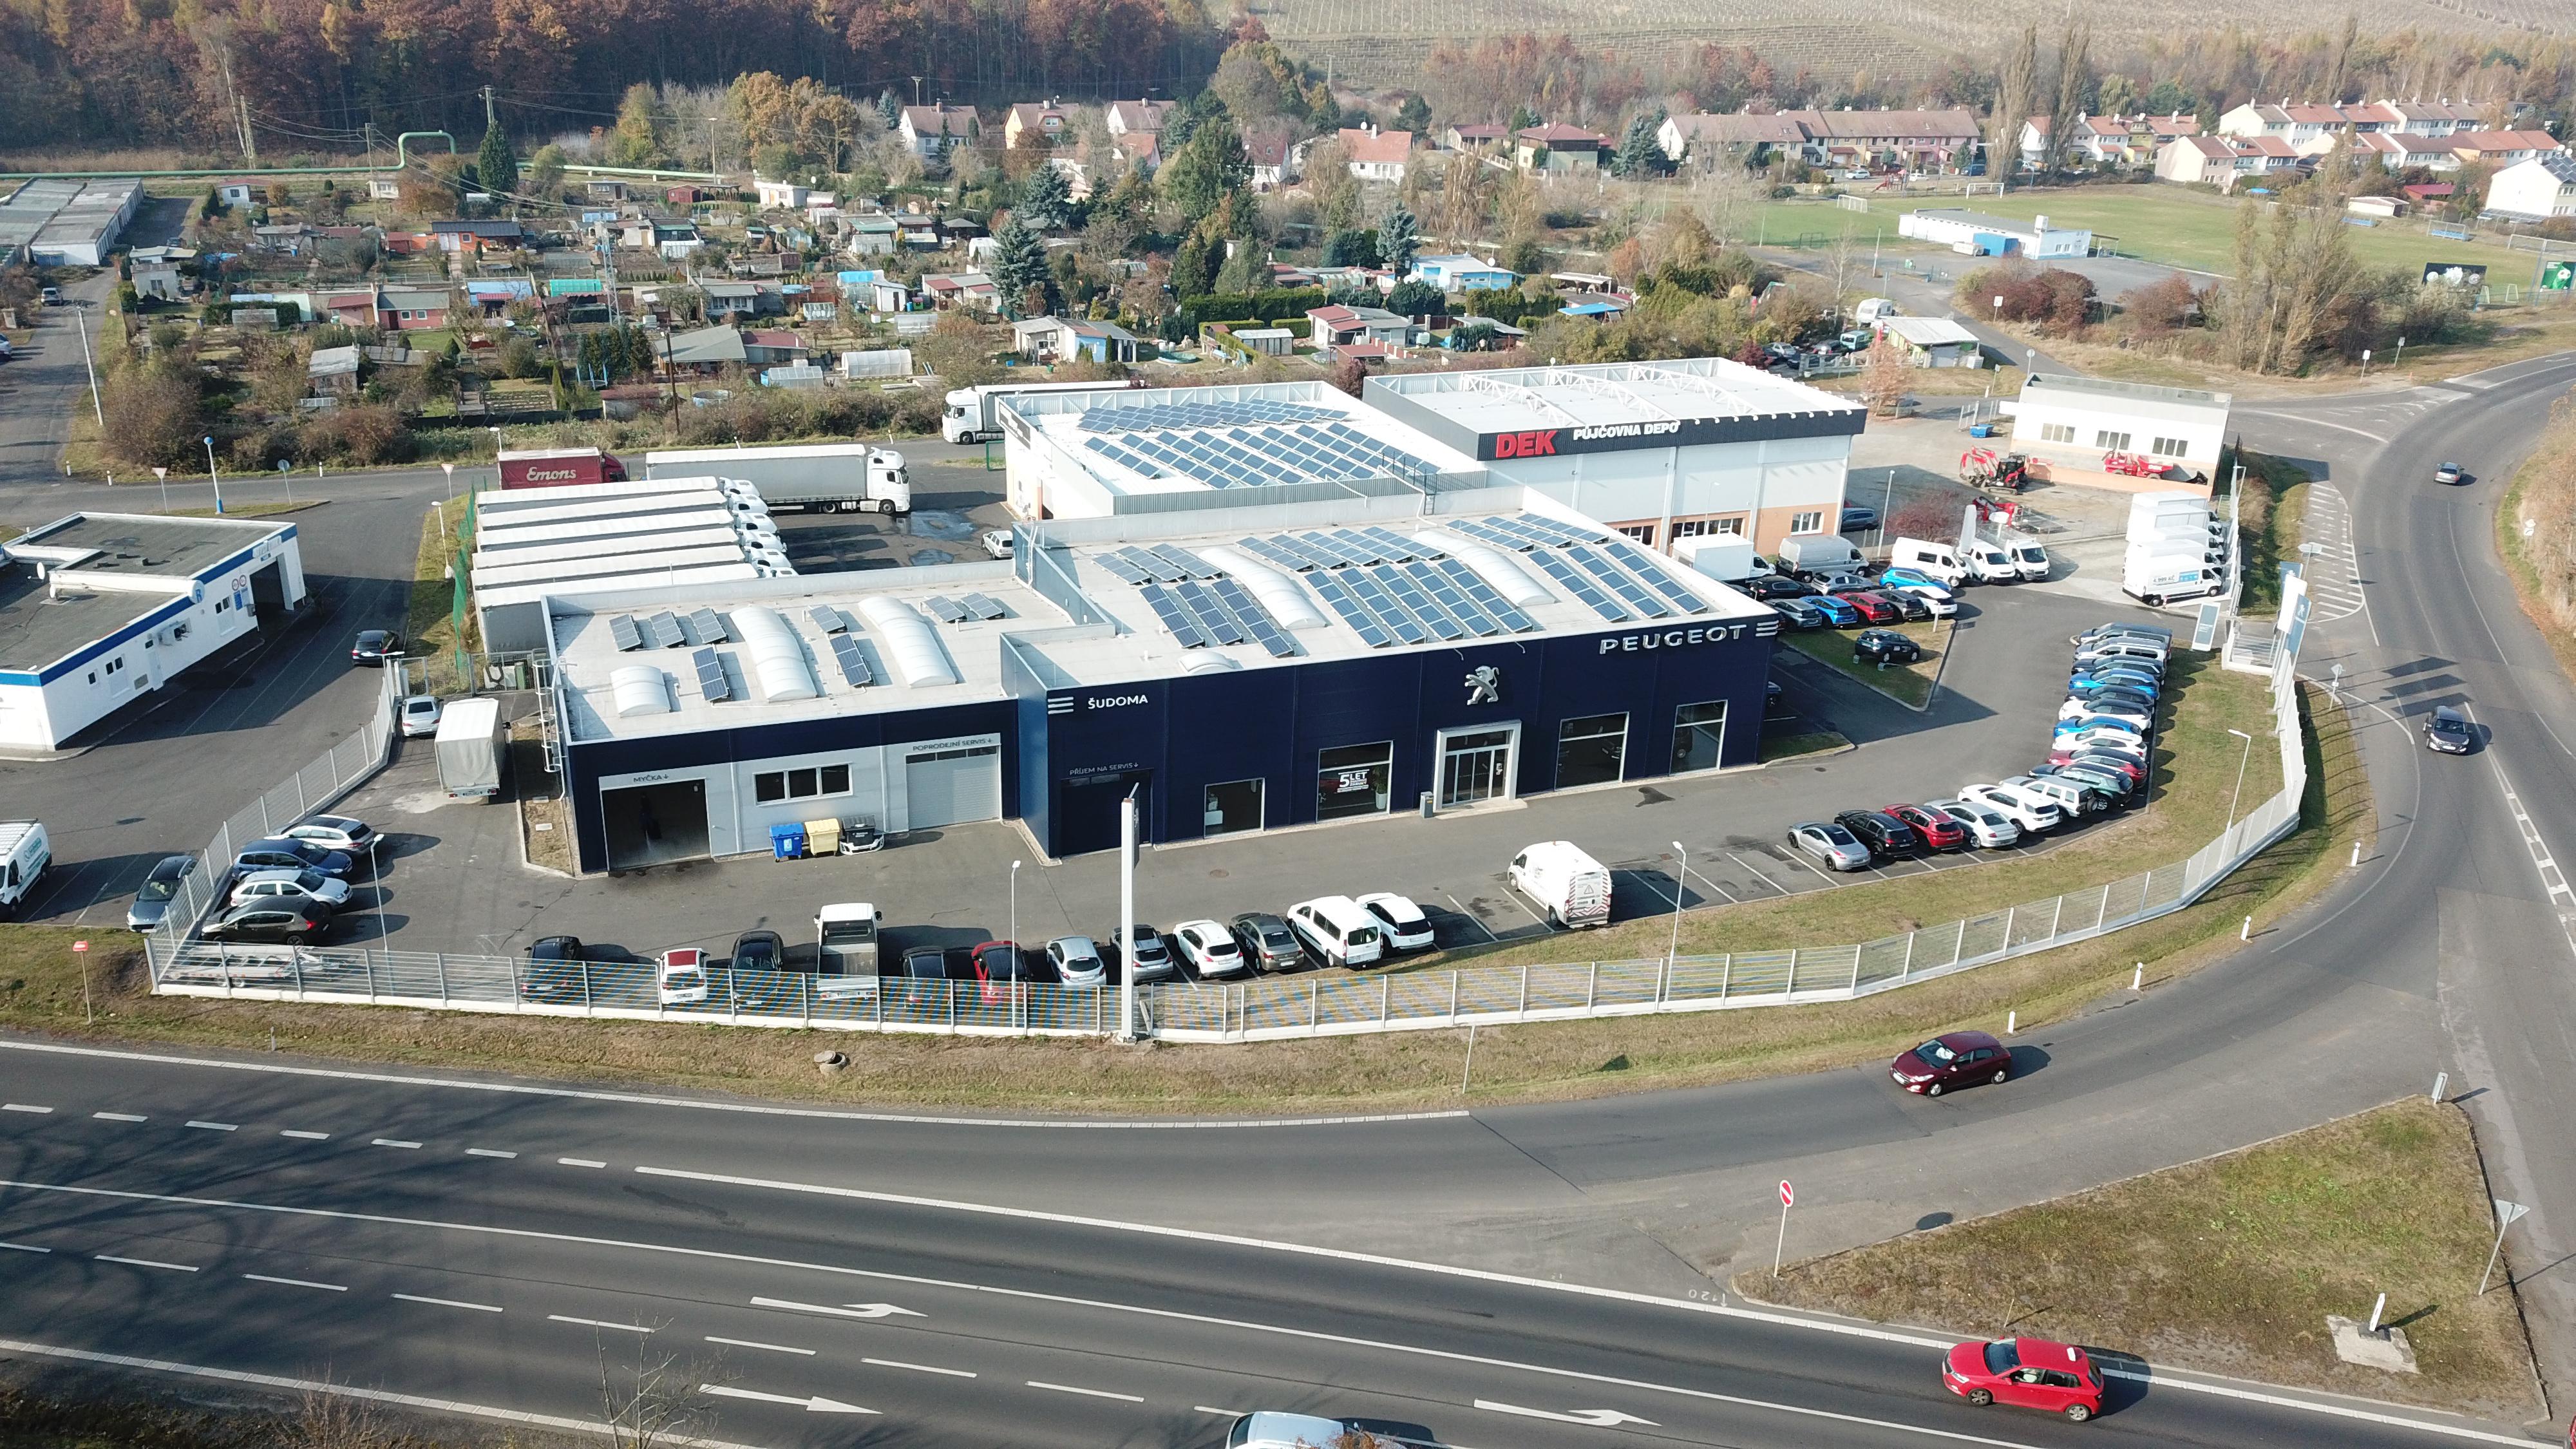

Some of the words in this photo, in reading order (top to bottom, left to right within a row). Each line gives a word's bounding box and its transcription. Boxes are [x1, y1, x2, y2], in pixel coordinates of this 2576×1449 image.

[1643, 420, 1680, 435] DEPO
[1495, 430, 1557, 458] DEK
[527, 466, 576, 481] Emons
[1599, 624, 1747, 654] PEUGEOT
[1088, 695, 1148, 709] ŠUDOMA
[913, 740, 960, 751] POPRODEJNÍ
[1340, 774, 1350, 788] 5
[1350, 772, 1367, 781] LET
